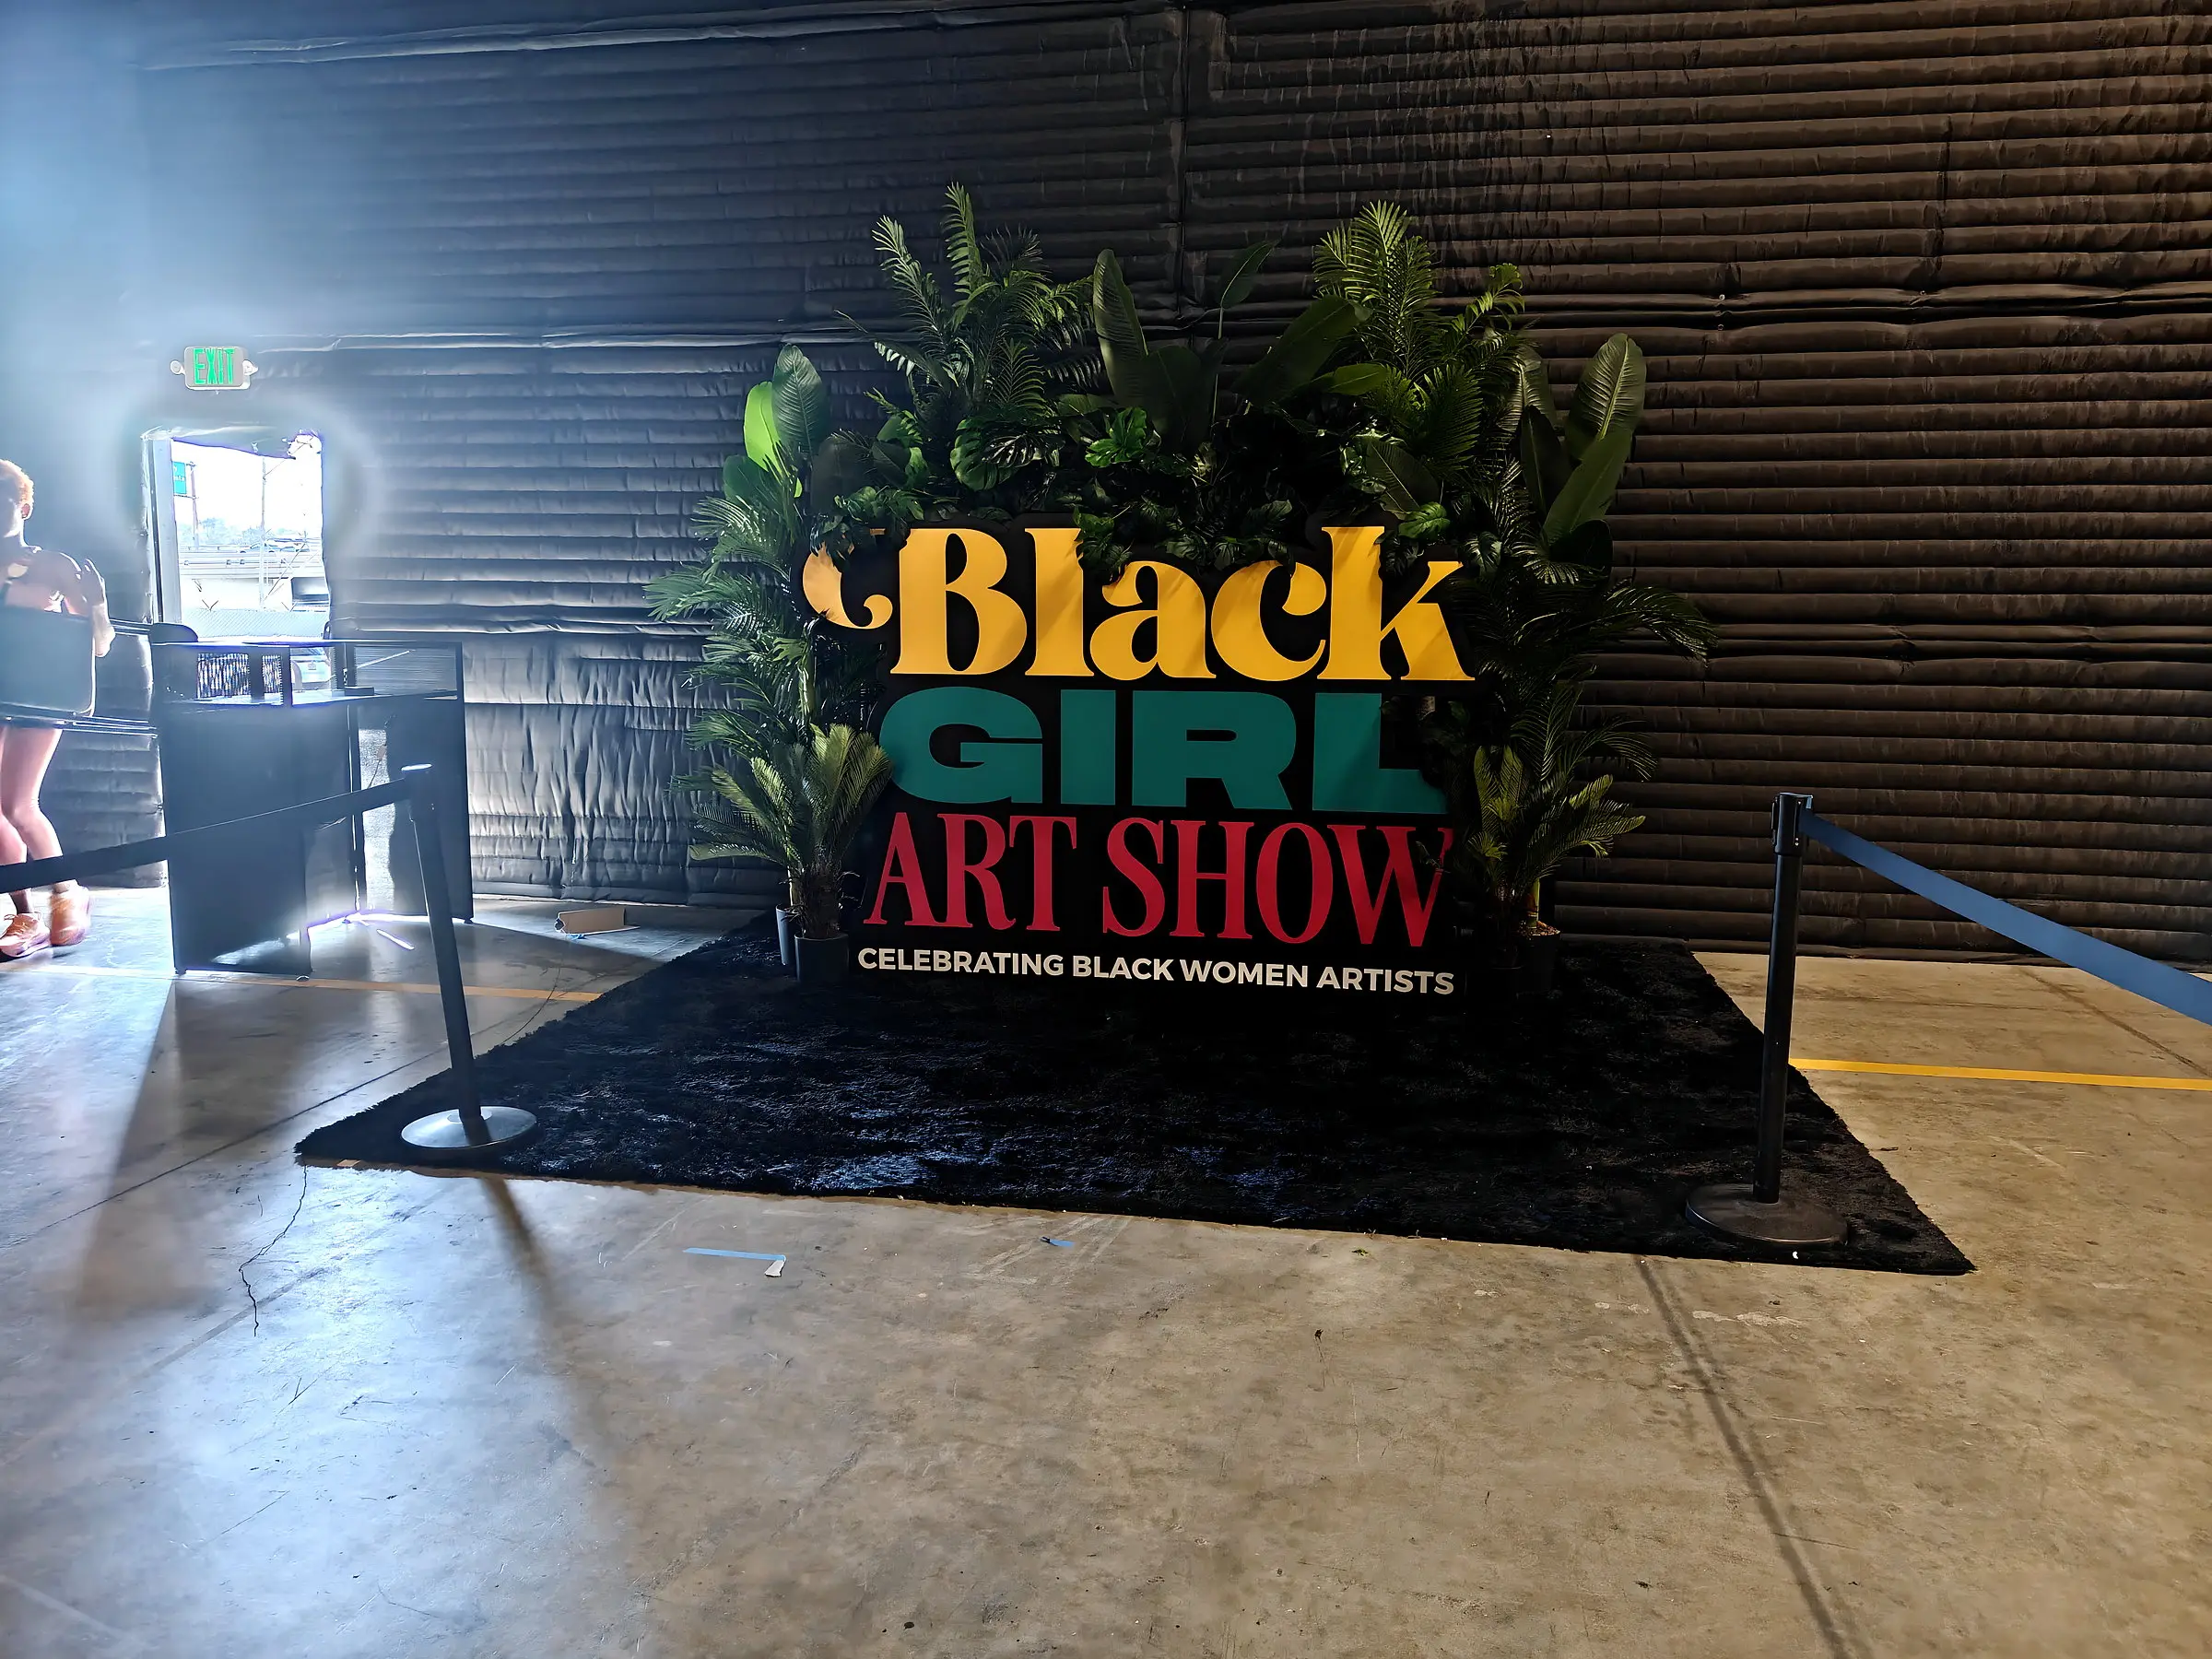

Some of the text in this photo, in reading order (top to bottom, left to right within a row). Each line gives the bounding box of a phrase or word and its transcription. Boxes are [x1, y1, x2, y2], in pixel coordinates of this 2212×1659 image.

[194, 348, 235, 384] EXIT
[803, 526, 1476, 682] Black
[878, 686, 1449, 815] GIRL
[863, 812, 1453, 947] ART SHOW
[858, 947, 1454, 994] CELEBRATING BLACK WOMEN ARTISTS
